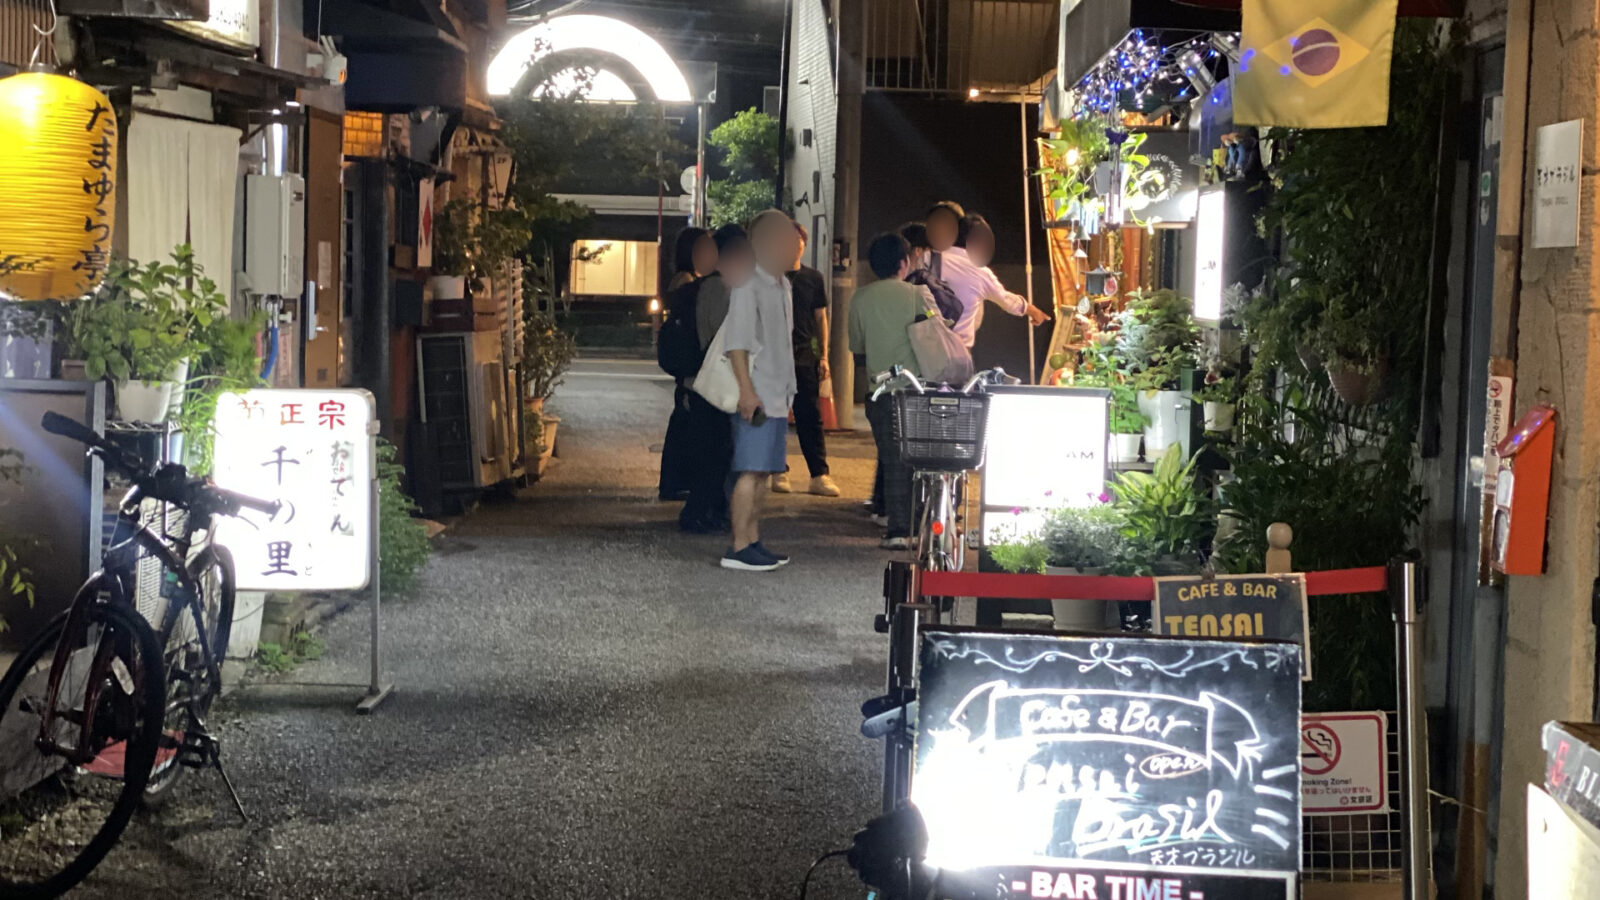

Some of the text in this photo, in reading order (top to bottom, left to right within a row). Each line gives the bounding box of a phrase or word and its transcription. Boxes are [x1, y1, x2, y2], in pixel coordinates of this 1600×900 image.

[72, 100, 115, 280] たまゆら亭
[1177, 582, 1278, 602] CAFE & BAR
[1164, 612, 1265, 638] TENSAI
[1019, 694, 1192, 739] Cafe & Bar
[1149, 847, 1256, 867] 天才ブラジル
[1031, 871, 1097, 900] BAR
[1105, 876, 1182, 900] TIME
